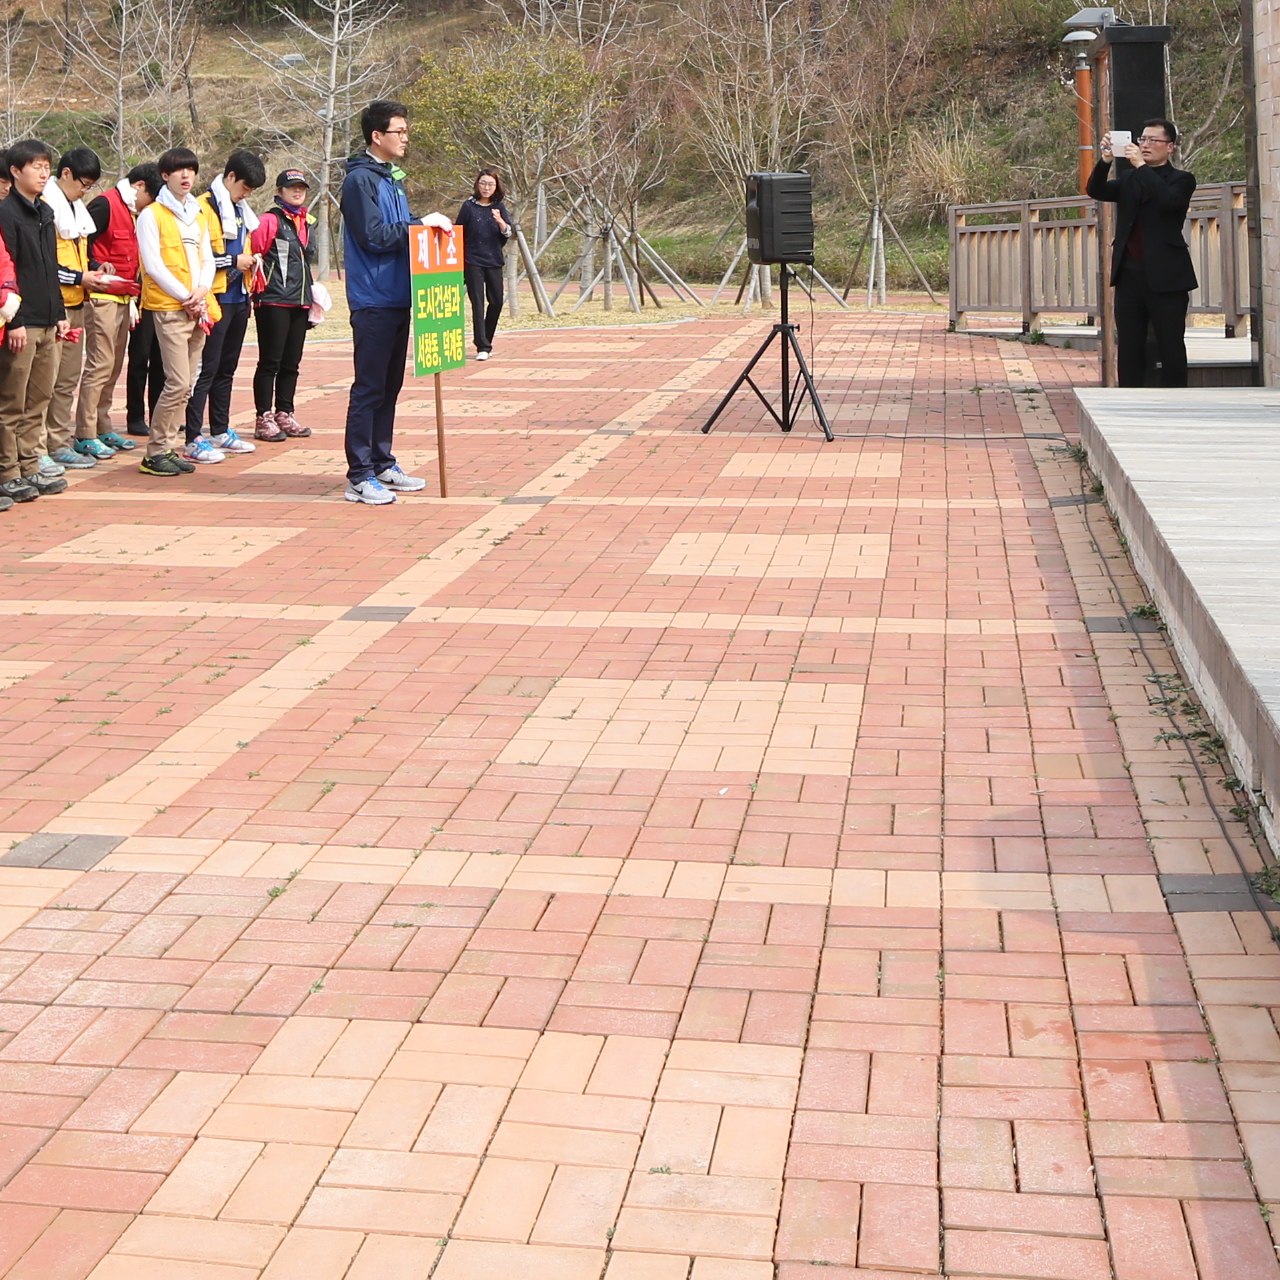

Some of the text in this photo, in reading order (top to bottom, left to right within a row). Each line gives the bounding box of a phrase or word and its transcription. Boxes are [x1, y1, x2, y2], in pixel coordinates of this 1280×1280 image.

[417, 283, 461, 320] 도시건설과
[417, 328, 463, 368] 서창동, 덕계동
